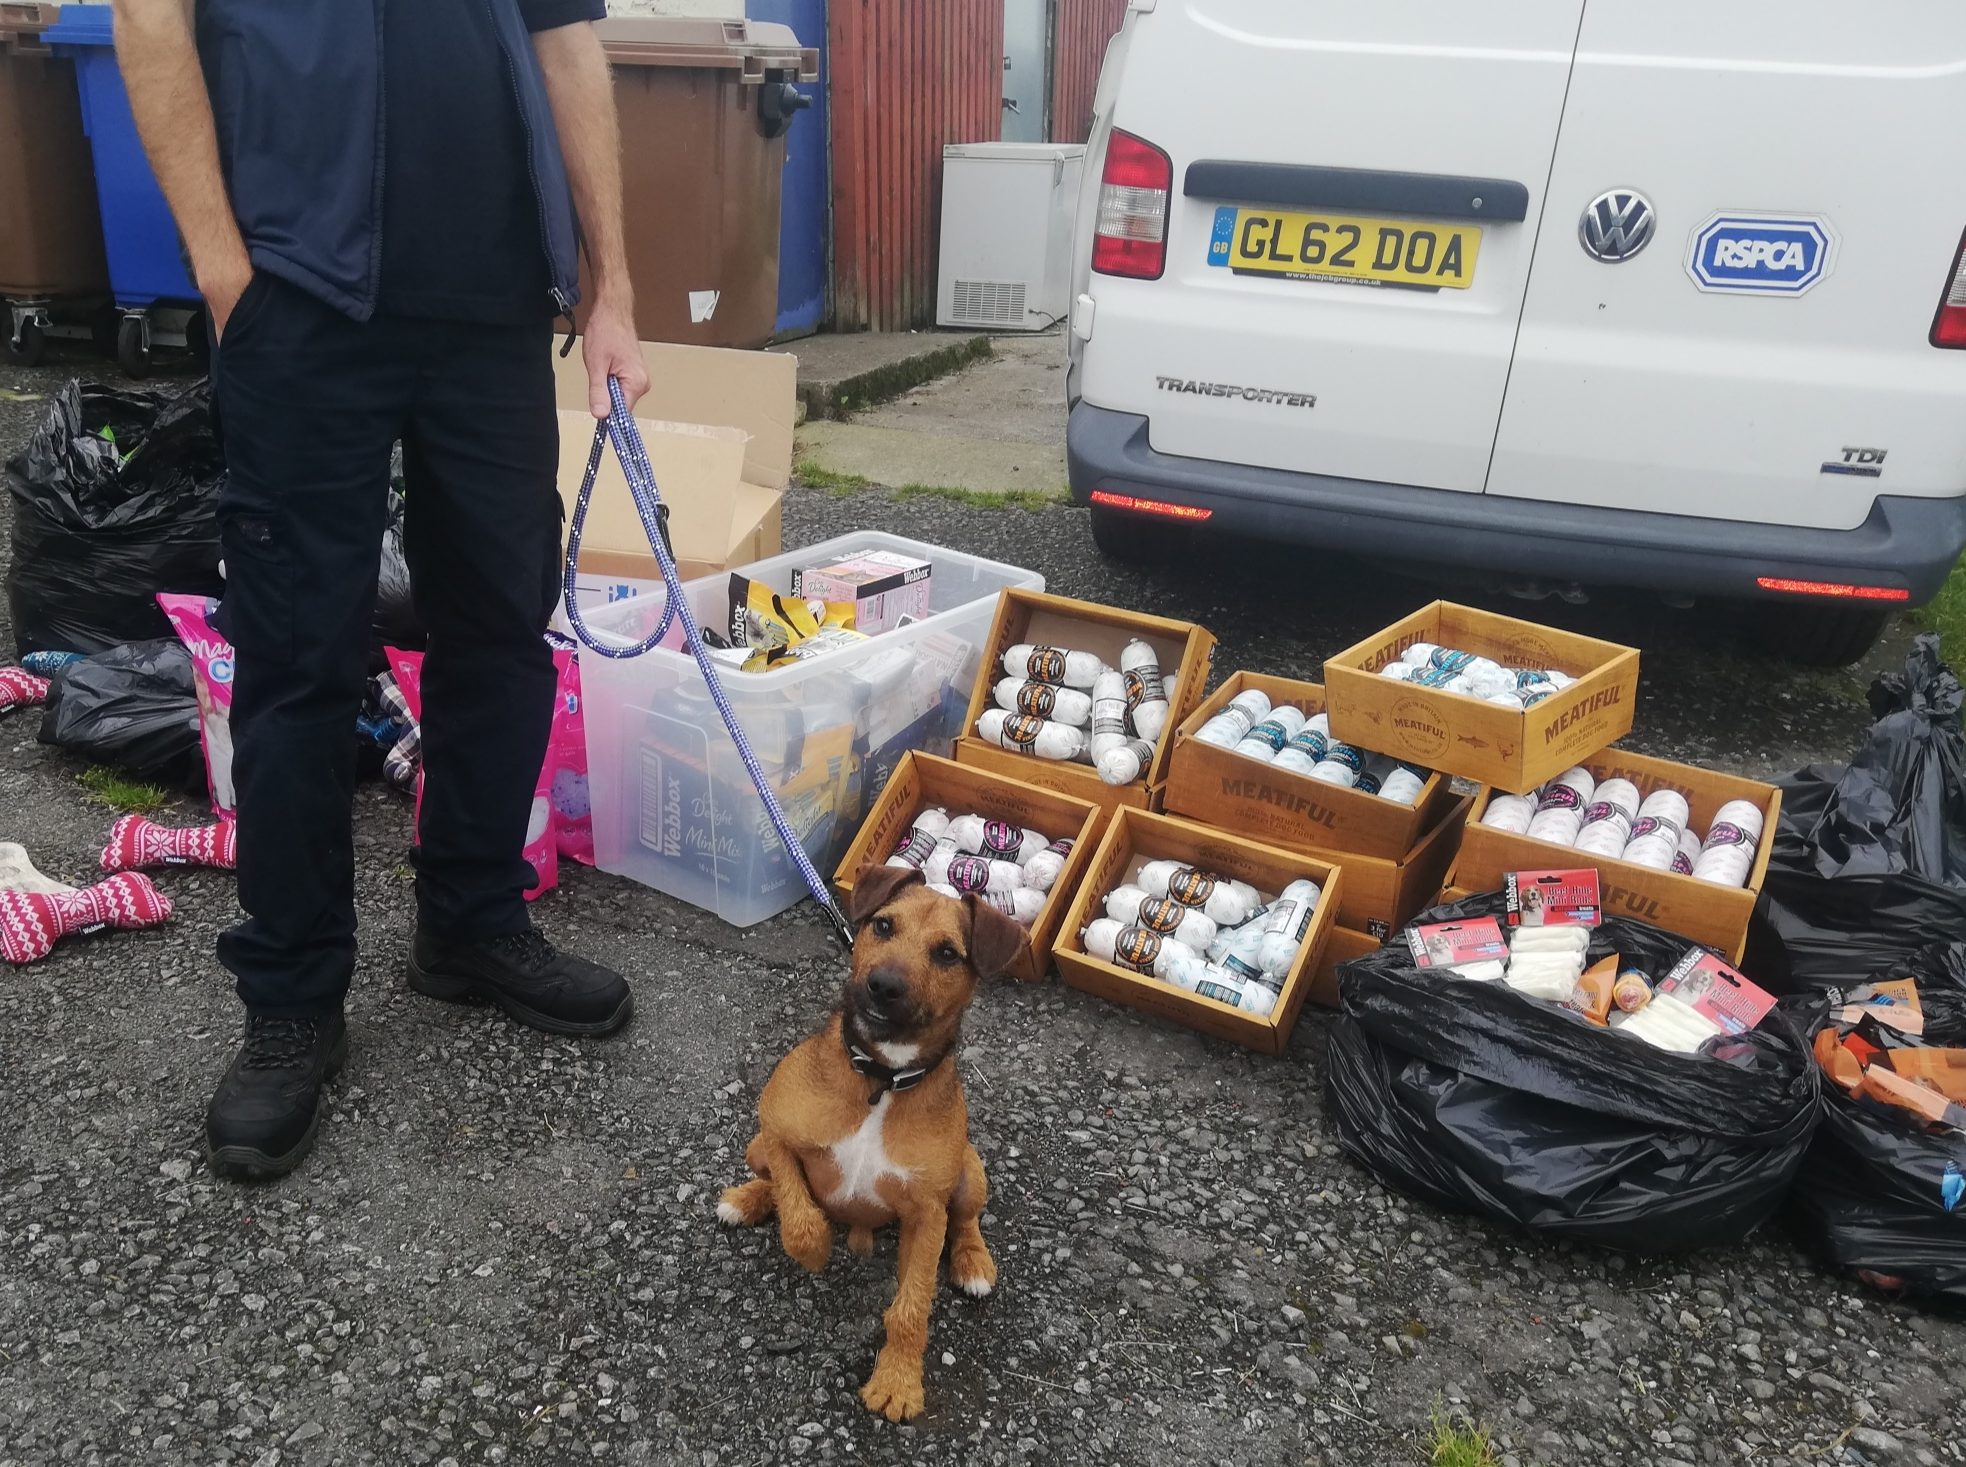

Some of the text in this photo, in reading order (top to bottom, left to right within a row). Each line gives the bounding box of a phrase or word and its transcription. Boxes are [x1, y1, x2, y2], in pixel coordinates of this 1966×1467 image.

[1213, 241, 1228, 254] GB
[1240, 217, 1462, 278] GL62 DOA
[1713, 238, 1805, 271] RSPCA
[1156, 376, 1317, 408] TRANSPORTER
[1841, 447, 1888, 464] TDI
[903, 568, 930, 585] Webbox
[1394, 718, 1446, 740] MEATIFUL
[1545, 686, 1621, 745] MEATIFUL
[664, 776, 681, 857] Webbox
[1221, 776, 1337, 830] MEATIFUL
[1270, 813, 1305, 831] NATURAL
[1505, 875, 1519, 912] Webbox
[82, 922, 106, 935] Webbox
[1410, 927, 1426, 957] Webbox
[1670, 949, 1704, 982] Webbox
